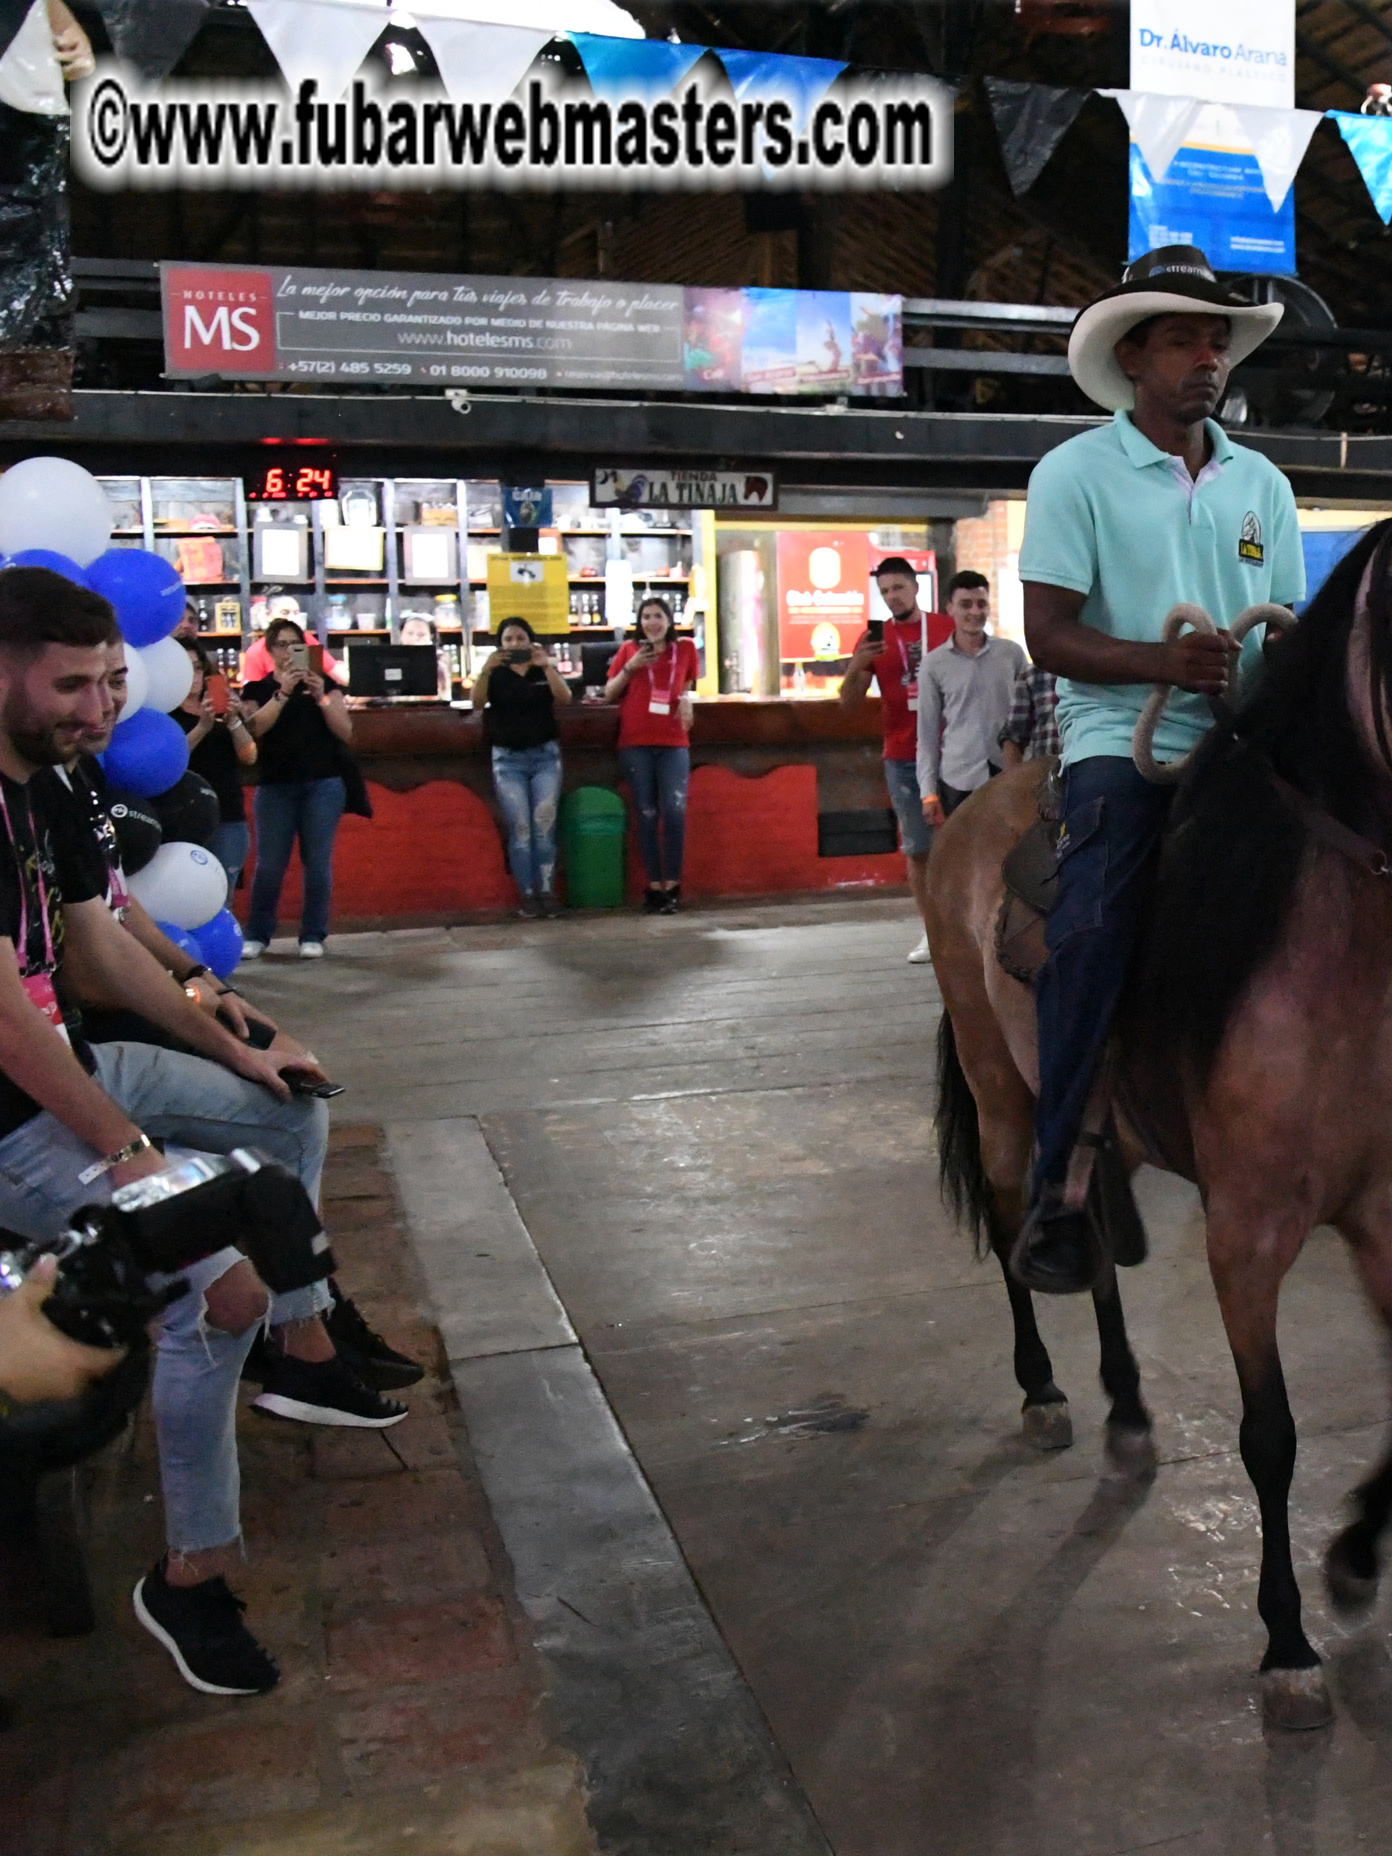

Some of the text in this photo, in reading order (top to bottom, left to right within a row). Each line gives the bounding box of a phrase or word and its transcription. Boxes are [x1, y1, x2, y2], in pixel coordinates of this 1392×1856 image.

[1170, 29, 1232, 60] Álvaro
[1234, 44, 1287, 67] Arana
[183, 290, 257, 302] HOTELES
[276, 274, 297, 297] La
[301, 283, 351, 304] mejor
[354, 285, 408, 305] opción
[407, 290, 449, 308] para
[483, 290, 527, 311] viajes
[531, 288, 552, 305] de
[615, 299, 627, 309] o
[625, 293, 679, 317] placer
[184, 305, 260, 351] MS
[299, 310, 337, 320] MEJOR
[340, 312, 381, 322] PRECIO
[384, 314, 462, 325] GARANTIZADO
[464, 317, 488, 326] POR
[490, 318, 526, 328] MEDIO
[528, 320, 543, 329] DE
[397, 329, 572, 350] www.hotelesms.com
[288, 360, 336, 374] +57(2)
[339, 362, 370, 373] 485
[374, 363, 412, 375] 5259
[430, 365, 446, 376] 01
[451, 366, 490, 378] 8000
[494, 367, 547, 379] 910098
[266, 467, 332, 493] 6:24
[671, 469, 717, 482] TIENDA
[649, 481, 737, 503] LA TINAJA
